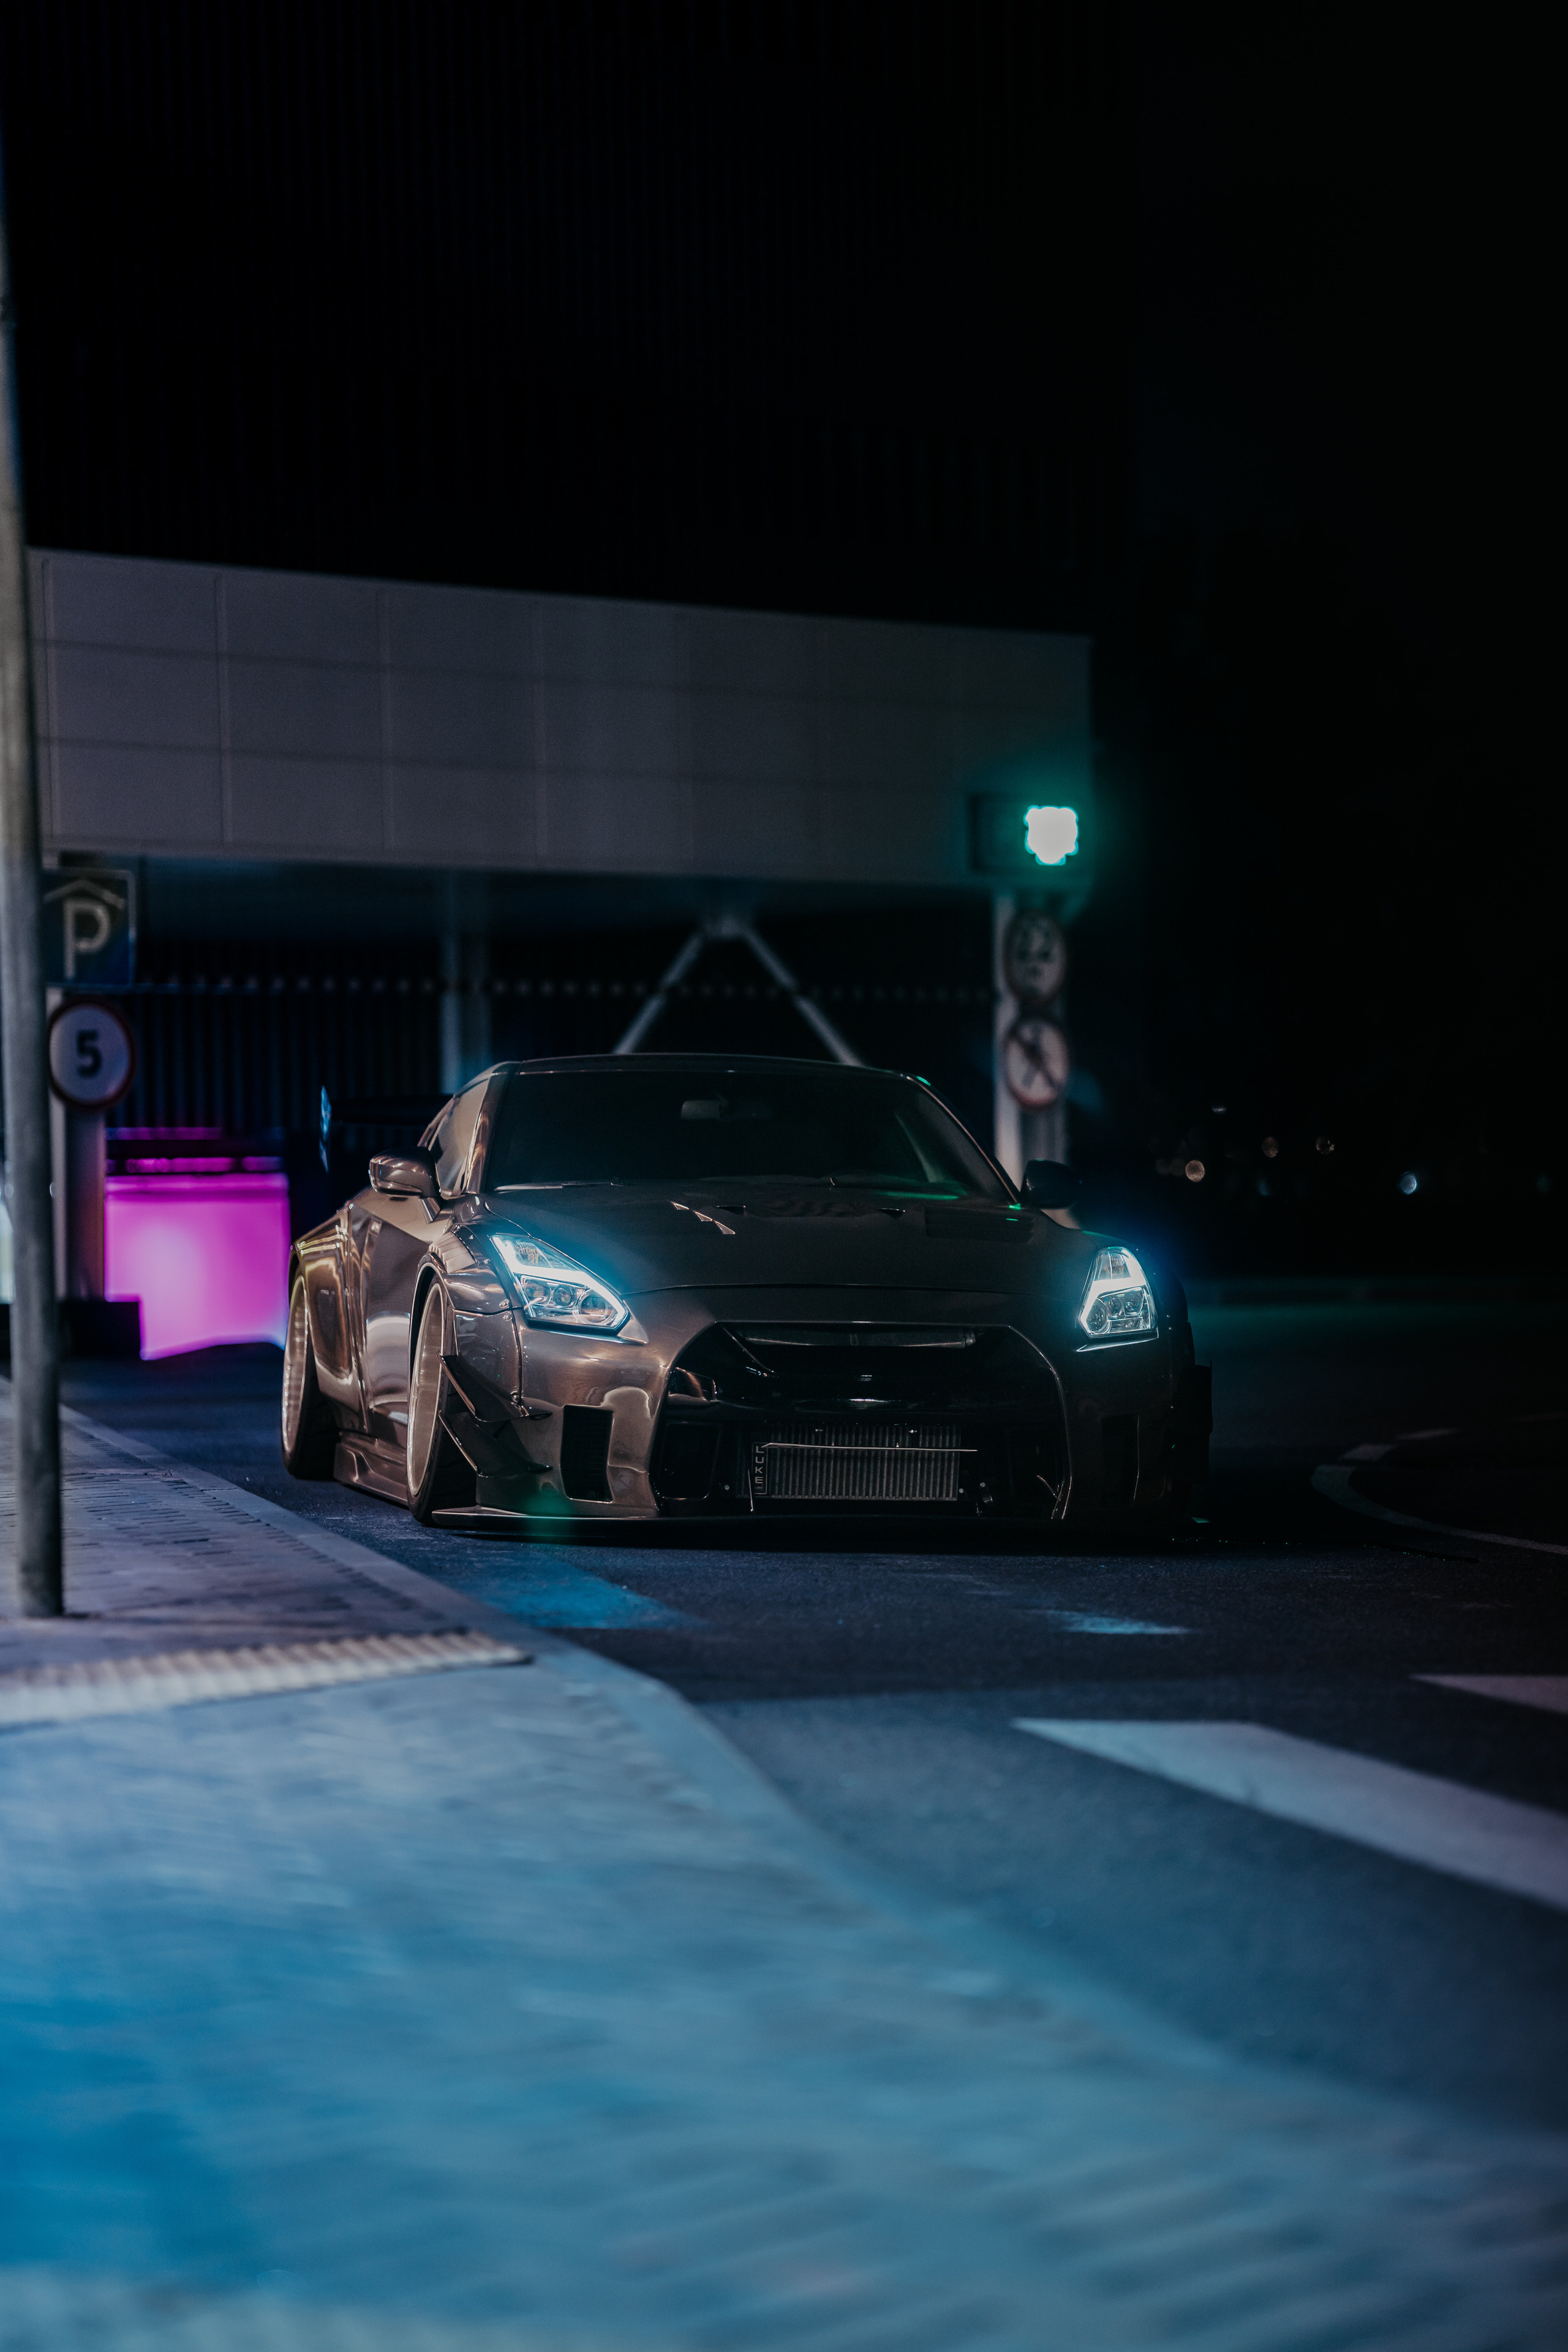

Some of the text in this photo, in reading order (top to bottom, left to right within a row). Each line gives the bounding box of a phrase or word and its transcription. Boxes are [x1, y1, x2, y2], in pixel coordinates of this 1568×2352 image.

[63, 898, 111, 979] P
[77, 1030, 100, 1077] 5
[755, 1446, 764, 1484] LUKE
